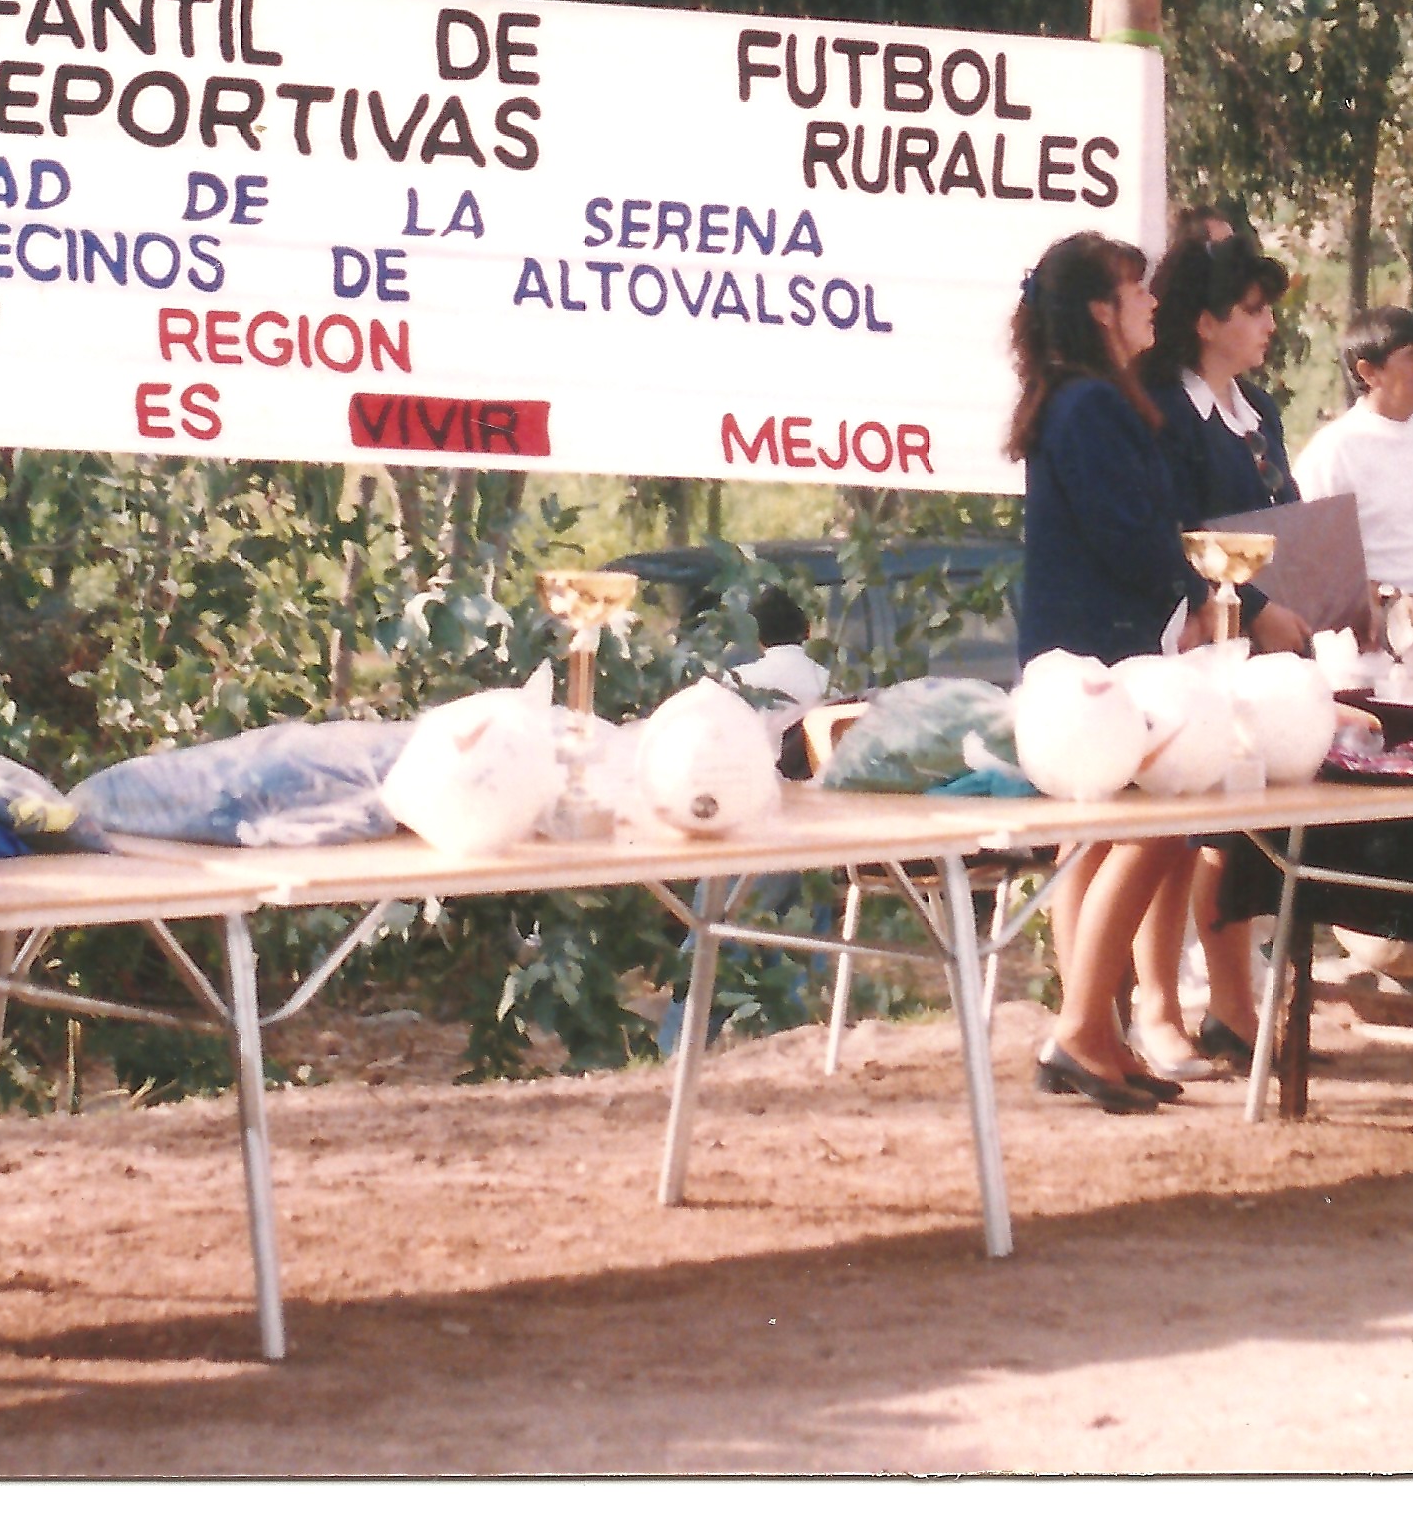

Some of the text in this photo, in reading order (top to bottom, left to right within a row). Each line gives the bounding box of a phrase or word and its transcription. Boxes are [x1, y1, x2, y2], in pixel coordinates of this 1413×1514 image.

[436, 9, 540, 85] DE
[738, 29, 1031, 120] FUTBOL
[803, 121, 1119, 207] RURALES
[182, 171, 268, 225] DE
[402, 188, 484, 239] LA
[585, 198, 823, 257] SERENA
[331, 246, 410, 301] DE
[514, 258, 892, 333] ALTOVALSOL
[159, 308, 411, 373] REGION
[135, 382, 222, 440] ES
[353, 398, 519, 454] VIVIR
[721, 413, 934, 474] MEJOR
